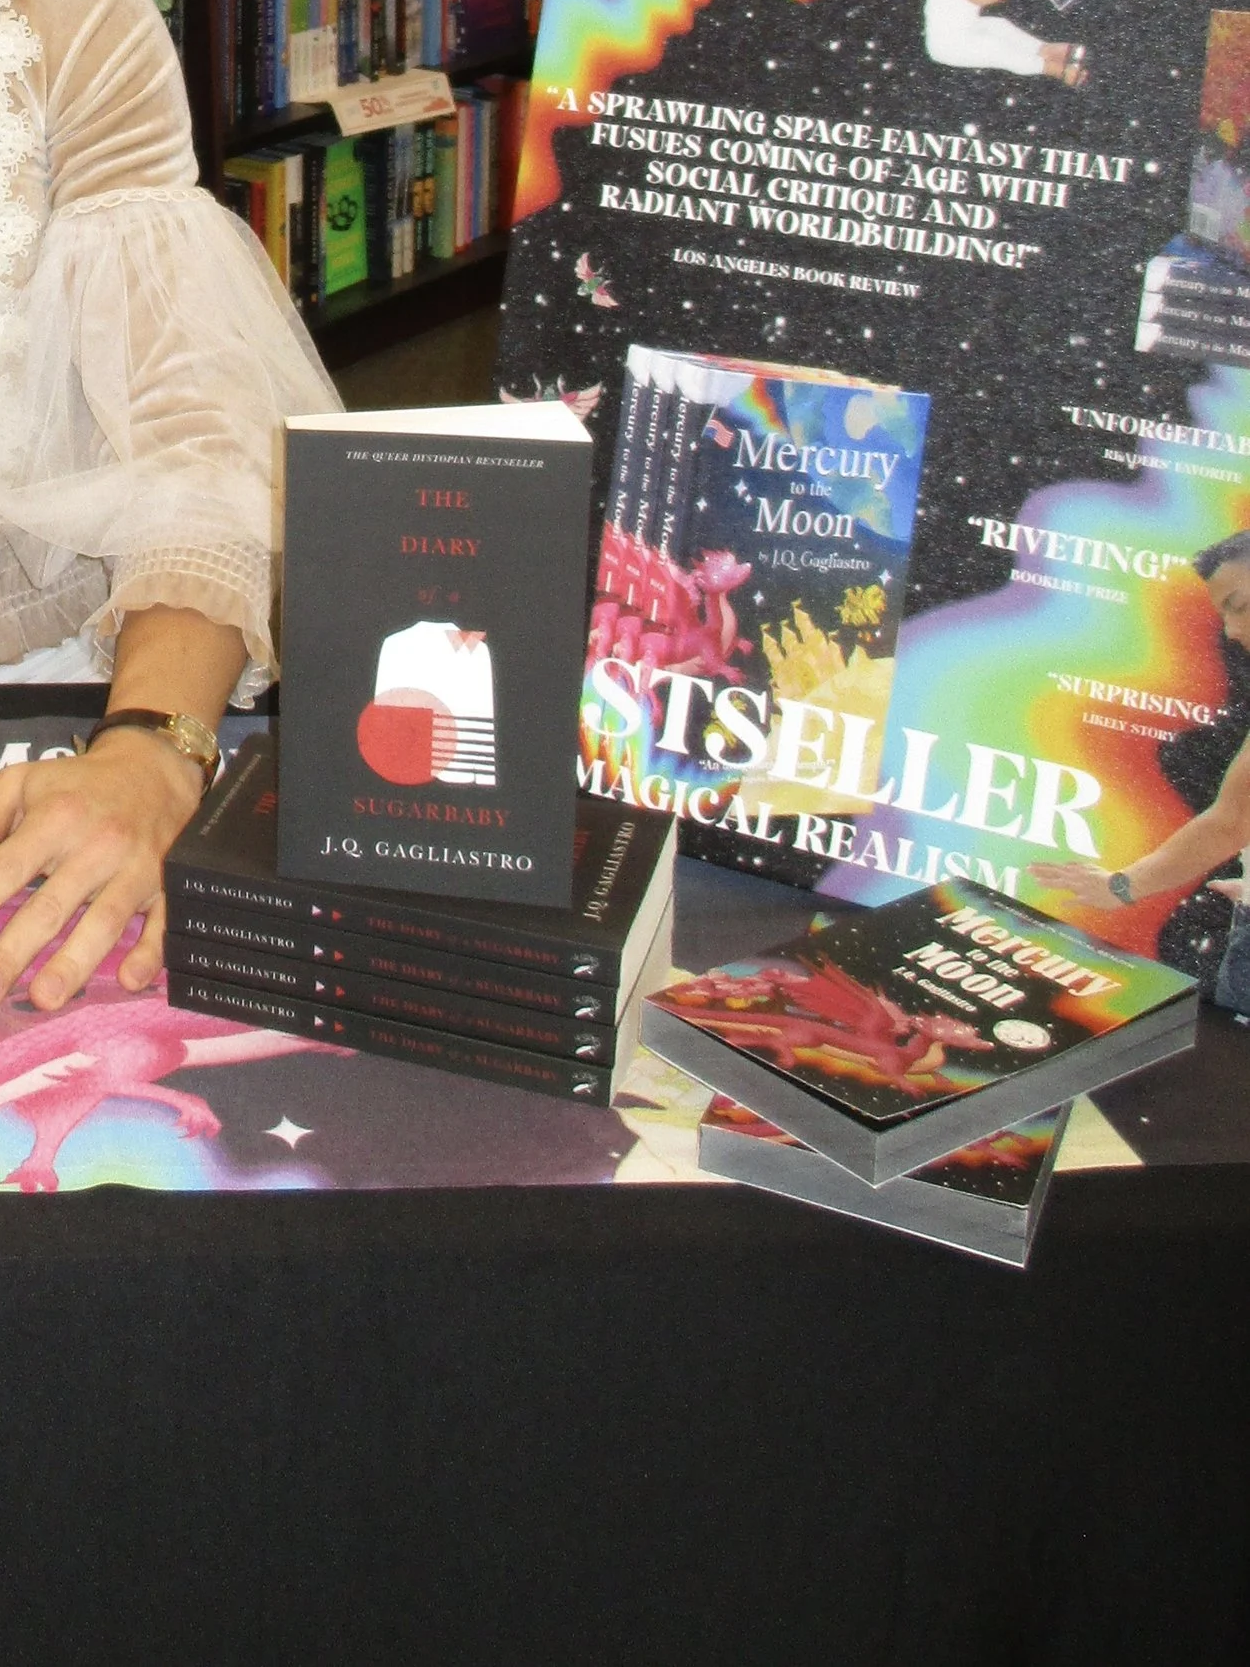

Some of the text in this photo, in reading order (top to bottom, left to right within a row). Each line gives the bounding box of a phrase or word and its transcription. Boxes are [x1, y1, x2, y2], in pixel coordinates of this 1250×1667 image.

[587, 90, 767, 136] SPRAWLING
[773, 113, 1034, 171] SPACE-FANTASY
[1040, 147, 1135, 184] THAT
[591, 121, 1071, 209] FUSUES COMING-OF-AGE WITH
[599, 183, 741, 227] RADIANT
[646, 159, 997, 231] SOCIAL CRITIQUE AND
[673, 248, 921, 299] LOS ANGELES BOOK REVIEW
[371, 451, 545, 469] QUEER DYSTOPIAN BESTSELLER
[1174, 461, 1243, 484] FAVORITE
[415, 489, 471, 510] THE
[400, 535, 481, 557] DIARY
[1086, 584, 1130, 605] PRIZE
[1081, 711, 1178, 744] LIKELY STORY
[583, 654, 1103, 861] STSELLER
[352, 795, 512, 828] SUGARBABY
[576, 753, 1024, 898] MAGICAL REALISM
[320, 835, 534, 873] J.Q. GAGLIASTRO
